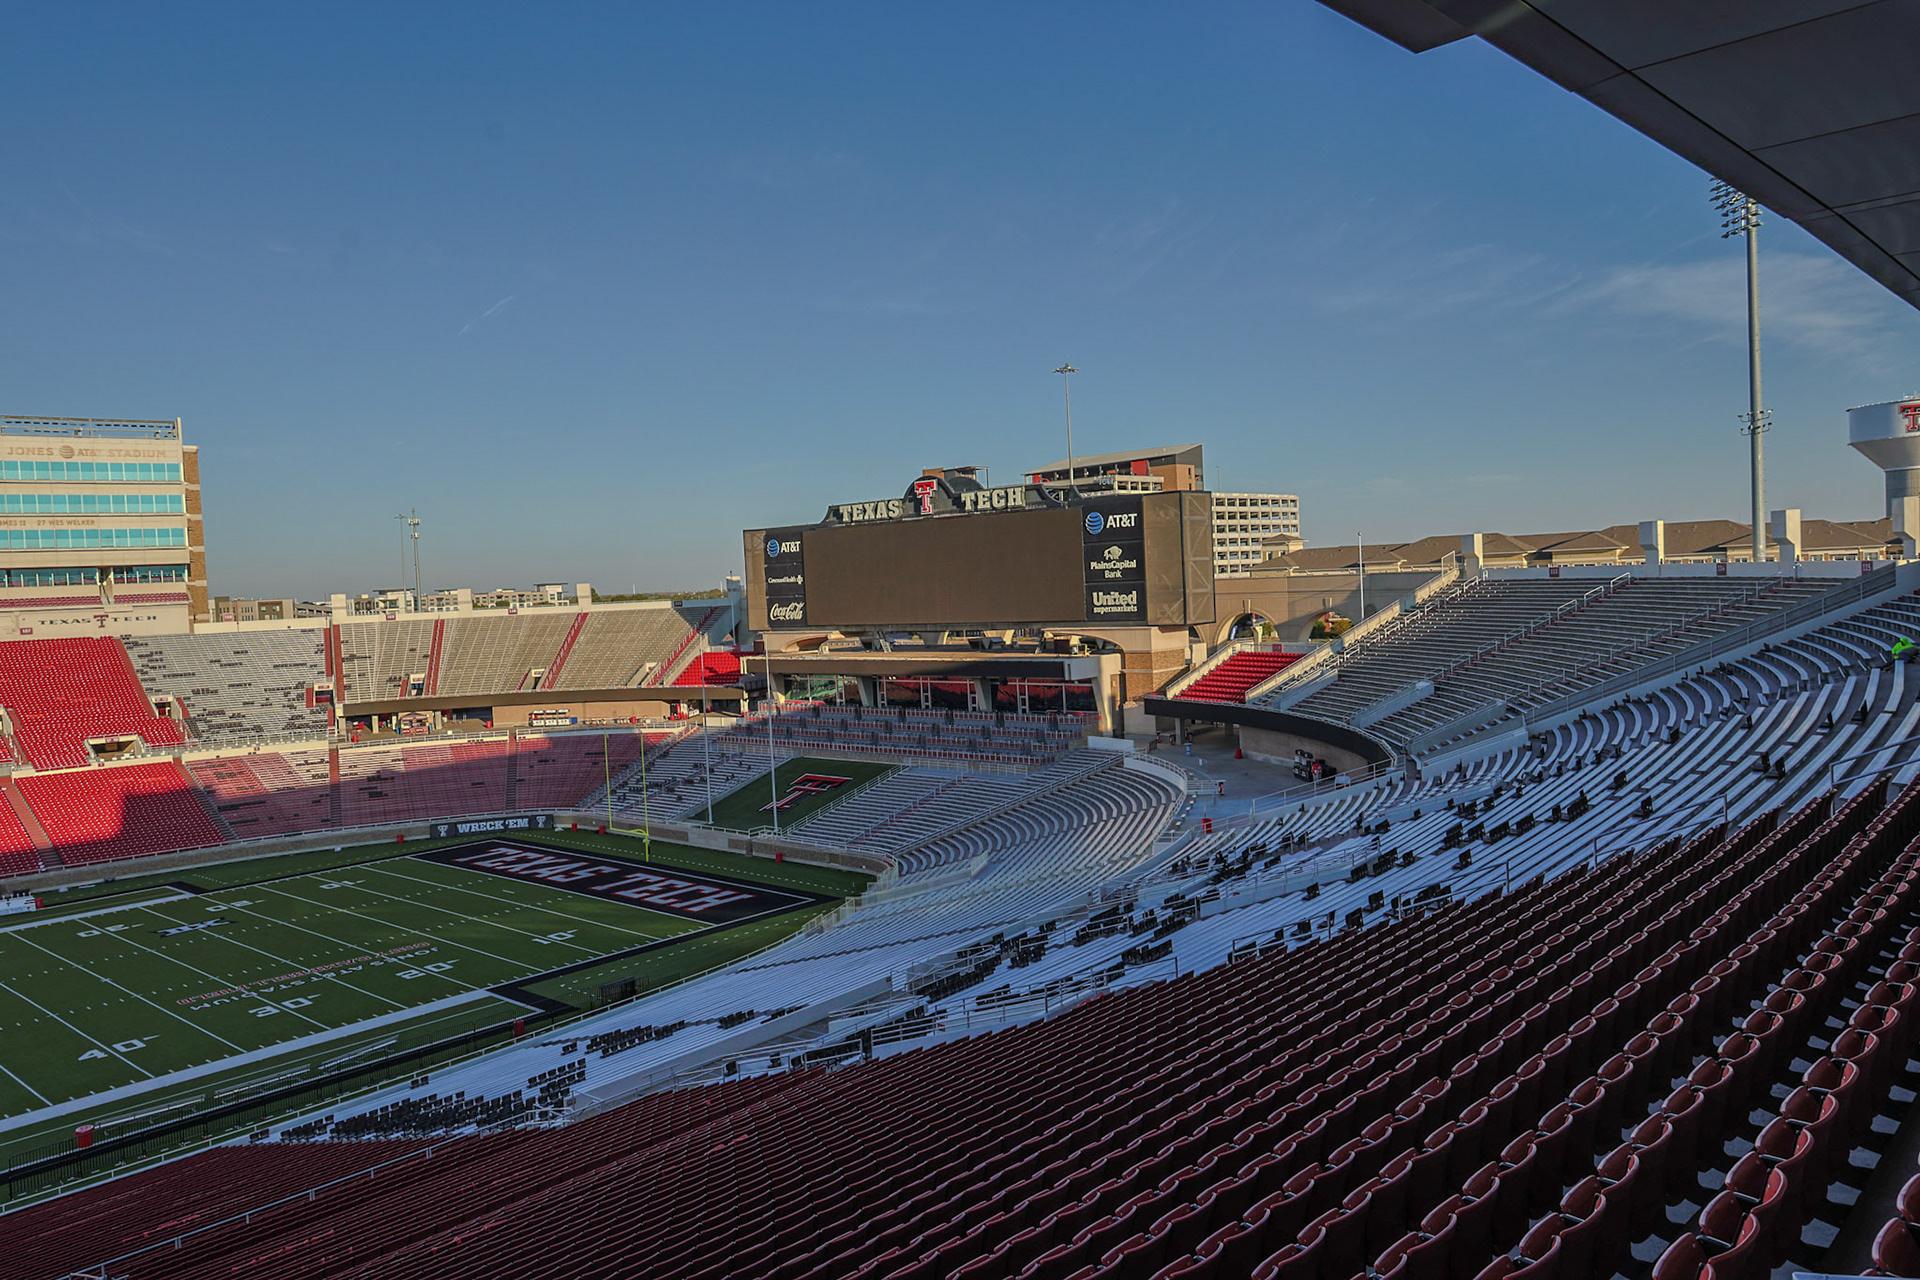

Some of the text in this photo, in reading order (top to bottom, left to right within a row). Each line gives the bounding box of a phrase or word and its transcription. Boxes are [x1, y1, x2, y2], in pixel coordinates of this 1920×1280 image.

[7, 446, 166, 458] JONES AT&T STADIUM
[839, 500, 902, 522] TEXAS
[961, 486, 1026, 511] TECH
[1106, 513, 1137, 529] AT&T
[780, 541, 801, 554] AT&T
[1090, 560, 1136, 571] PlainsCapital
[1104, 570, 1122, 579] Bank
[1092, 590, 1137, 606] United
[1093, 604, 1138, 614] supermarkets
[38, 617, 91, 625] TEXAS
[457, 820, 504, 834] WRECK
[452, 847, 757, 912] TEXAS TECH
[395, 962, 455, 980] 20
[248, 997, 314, 1018] 30
[78, 1038, 147, 1061] 40
